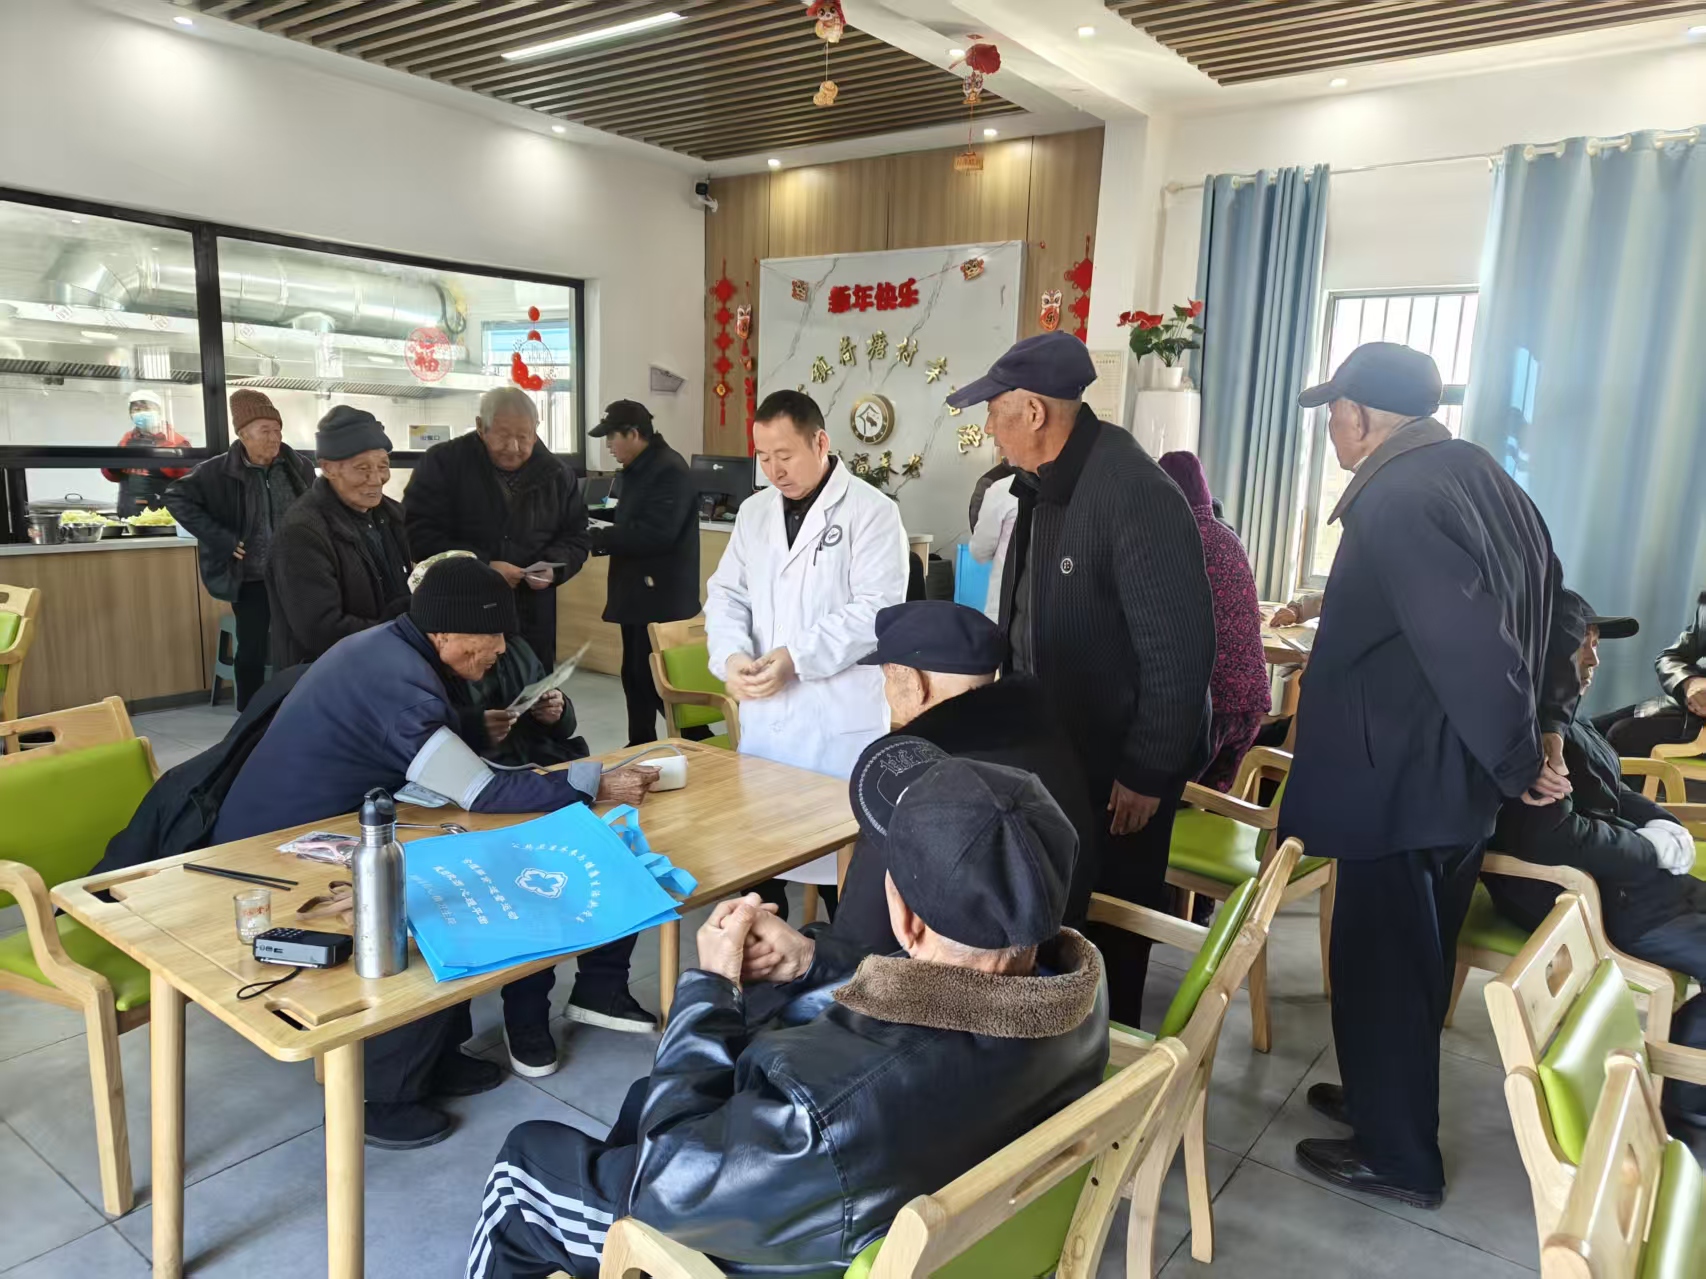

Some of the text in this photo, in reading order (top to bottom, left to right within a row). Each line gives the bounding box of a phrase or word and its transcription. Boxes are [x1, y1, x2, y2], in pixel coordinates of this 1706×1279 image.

[828, 277, 920, 314] 新年快乐
[797, 330, 983, 454] 镇荷塘村幸院
